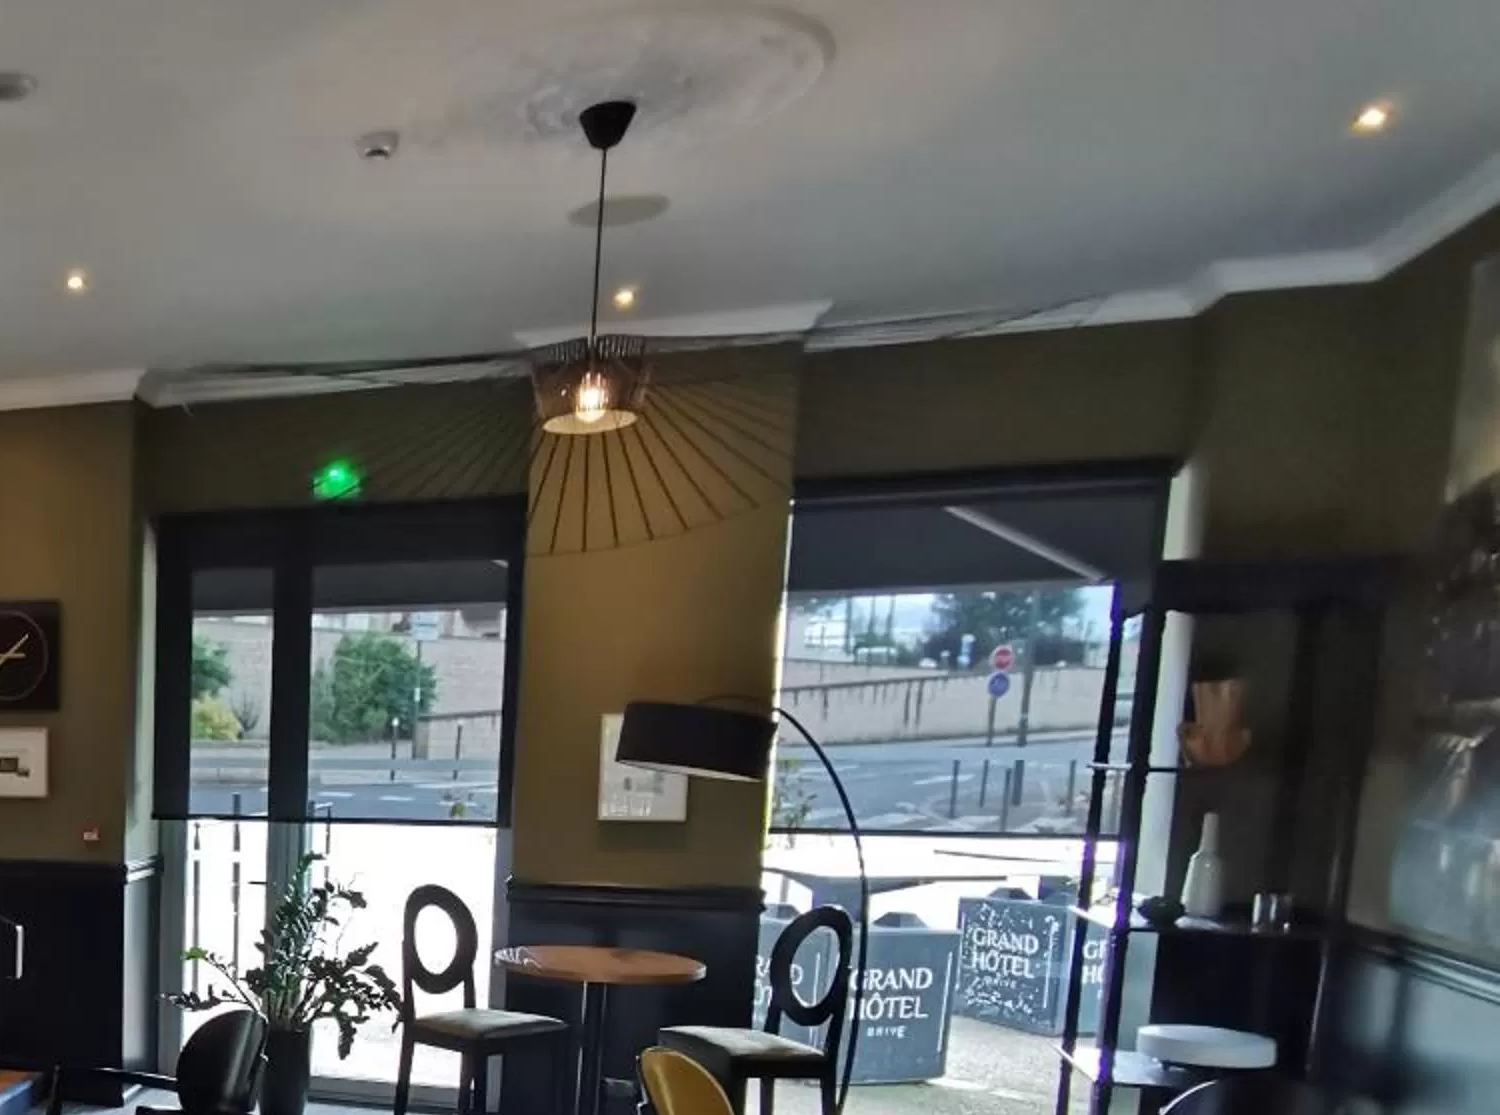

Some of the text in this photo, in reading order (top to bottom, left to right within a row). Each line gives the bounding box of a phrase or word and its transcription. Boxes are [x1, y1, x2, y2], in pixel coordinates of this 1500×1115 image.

[973, 928, 1039, 955] GRAND
[849, 967, 933, 991] GRAND
[849, 992, 929, 1020] HÔTEL
